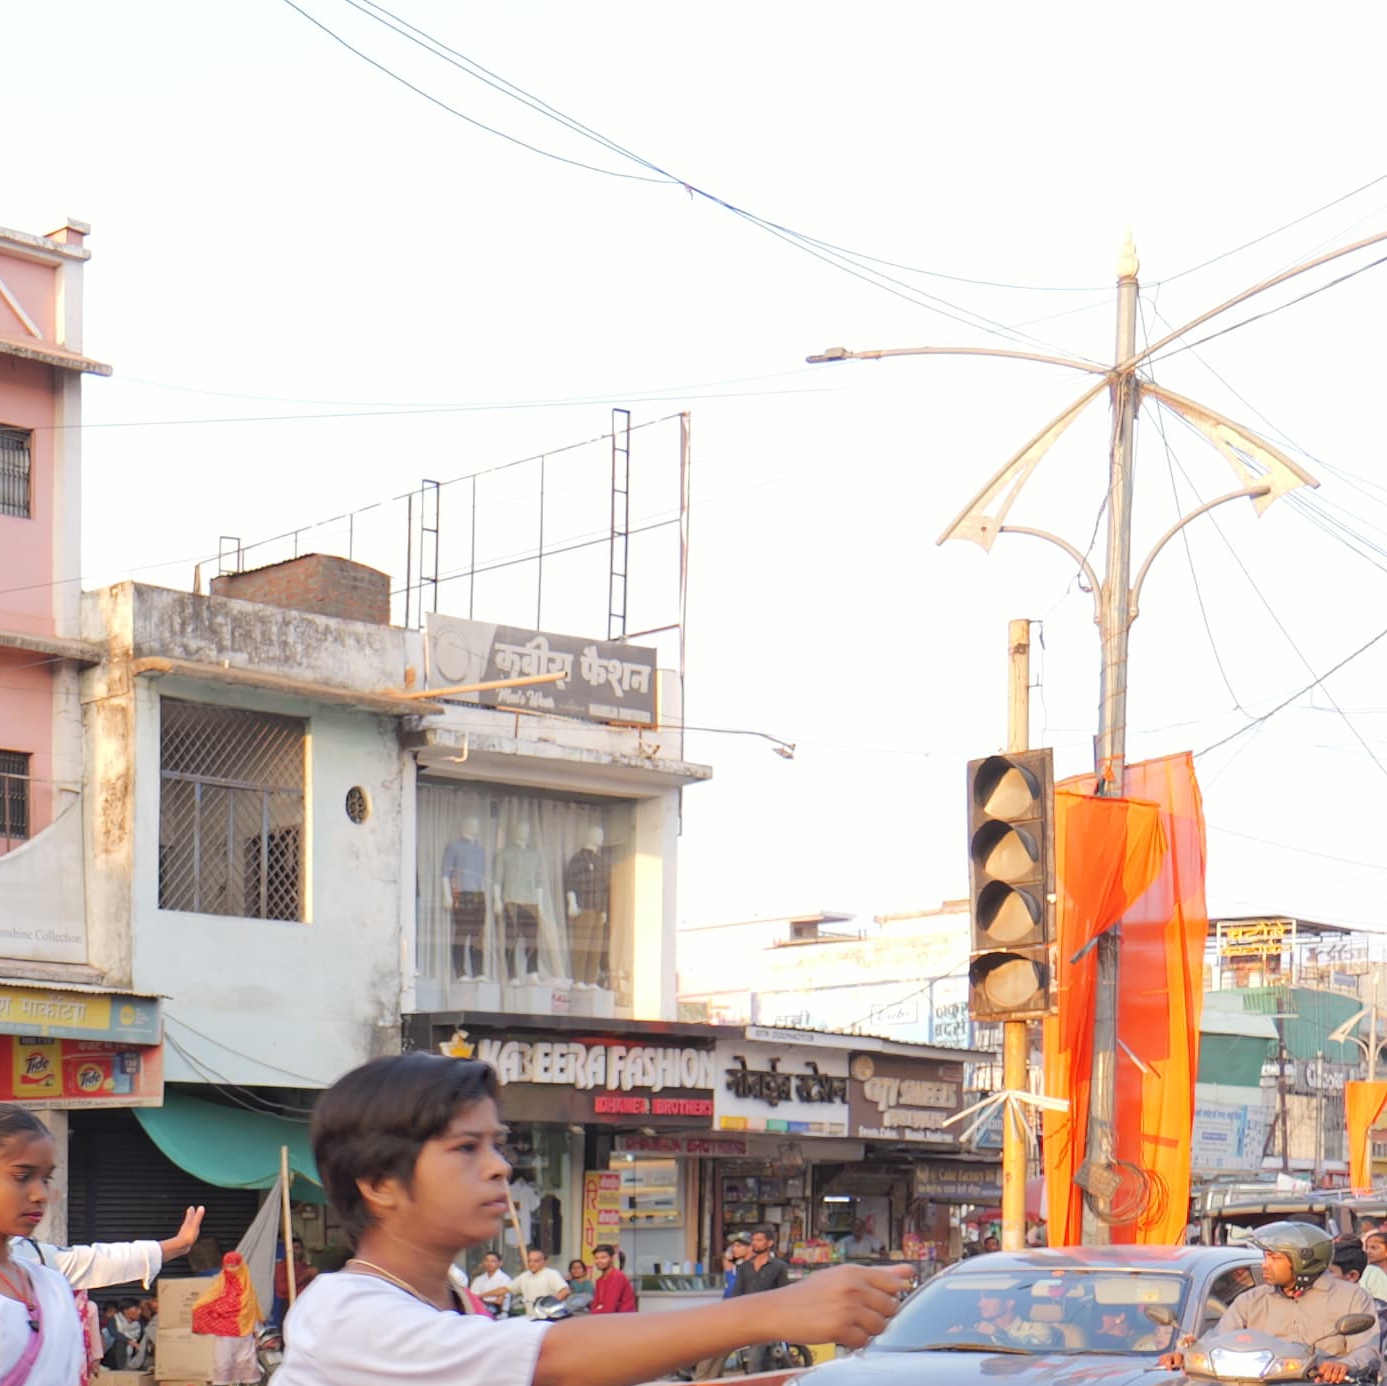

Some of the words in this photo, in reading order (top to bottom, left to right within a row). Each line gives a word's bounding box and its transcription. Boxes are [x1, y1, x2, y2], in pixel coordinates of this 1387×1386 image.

[580, 644, 651, 697] फैशन
[34, 929, 83, 945] Collection
[27, 1057, 50, 1074] Tide
[477, 1039, 606, 1090] KABEERA
[607, 1045, 716, 1092] FASHION
[79, 1071, 101, 1086] Tide
[652, 1098, 714, 1116] BROTHERS
